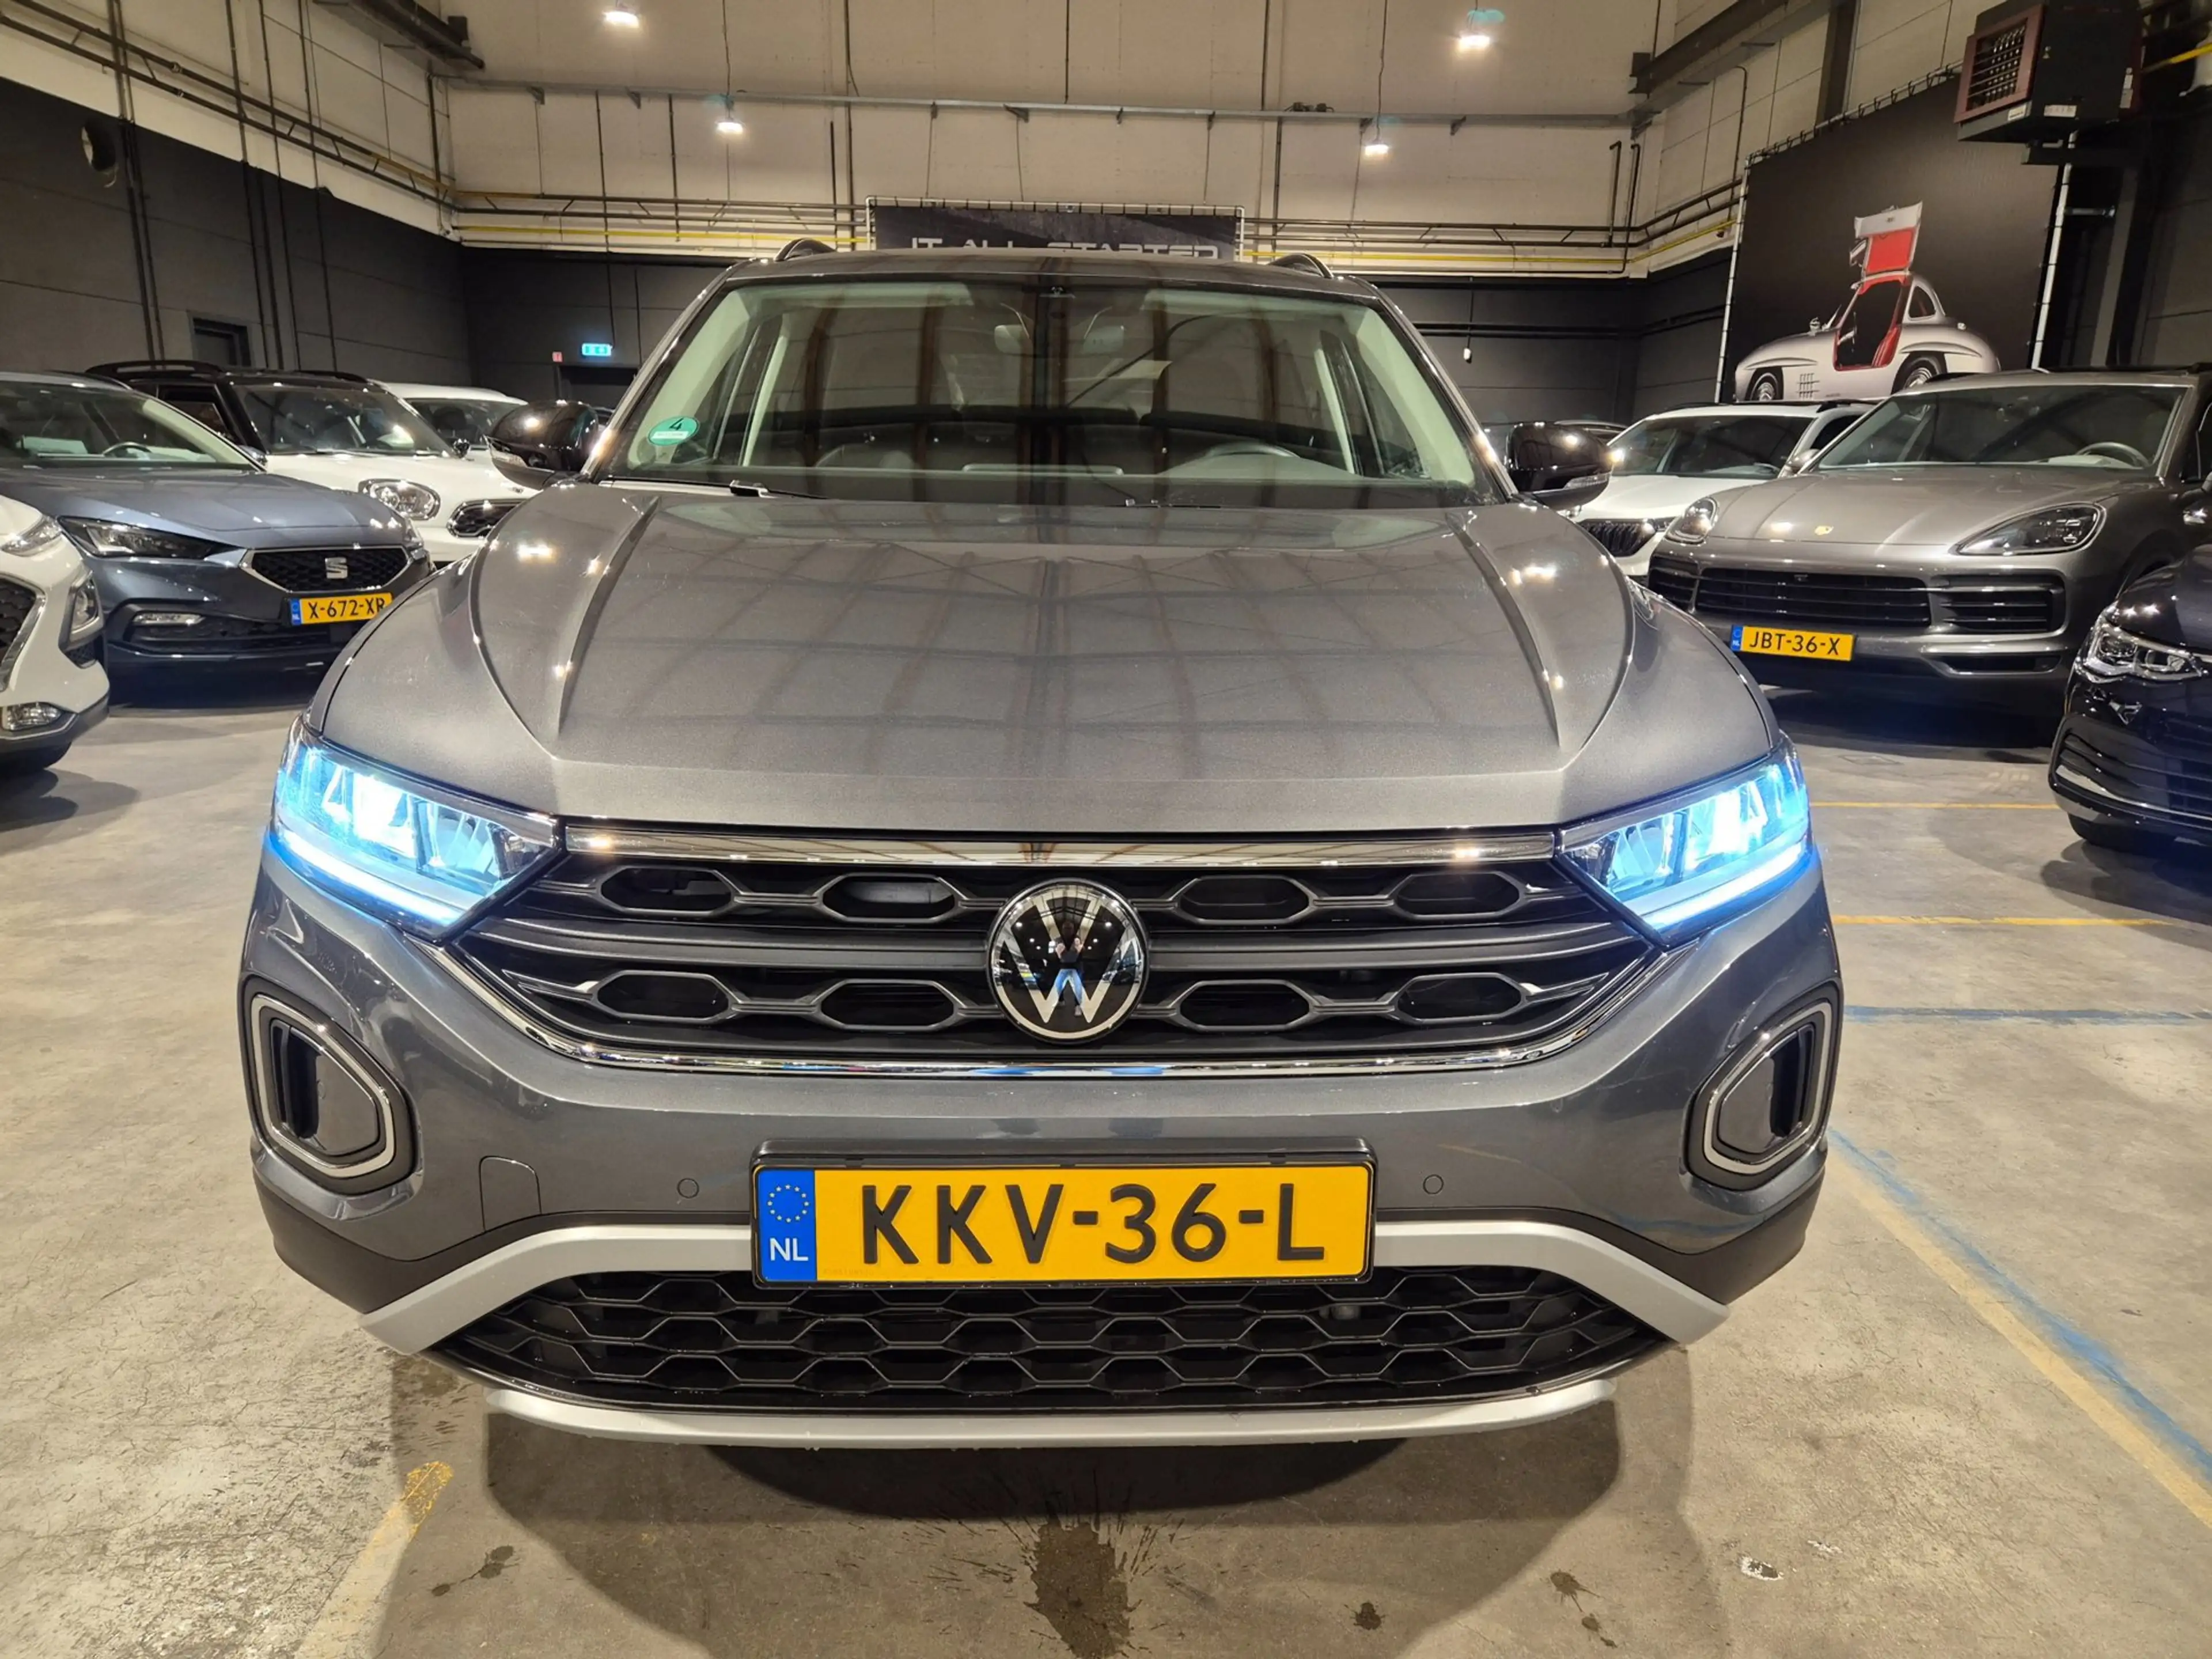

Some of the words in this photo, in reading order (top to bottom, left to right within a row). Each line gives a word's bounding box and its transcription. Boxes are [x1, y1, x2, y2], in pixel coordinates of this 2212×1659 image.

[1047, 242, 1218, 259] RTED
[668, 418, 684, 430] 4
[1749, 631, 1840, 656] JBT-36-X
[862, 1183, 1324, 1264] KKV-36-L
[769, 1237, 809, 1261] NL
